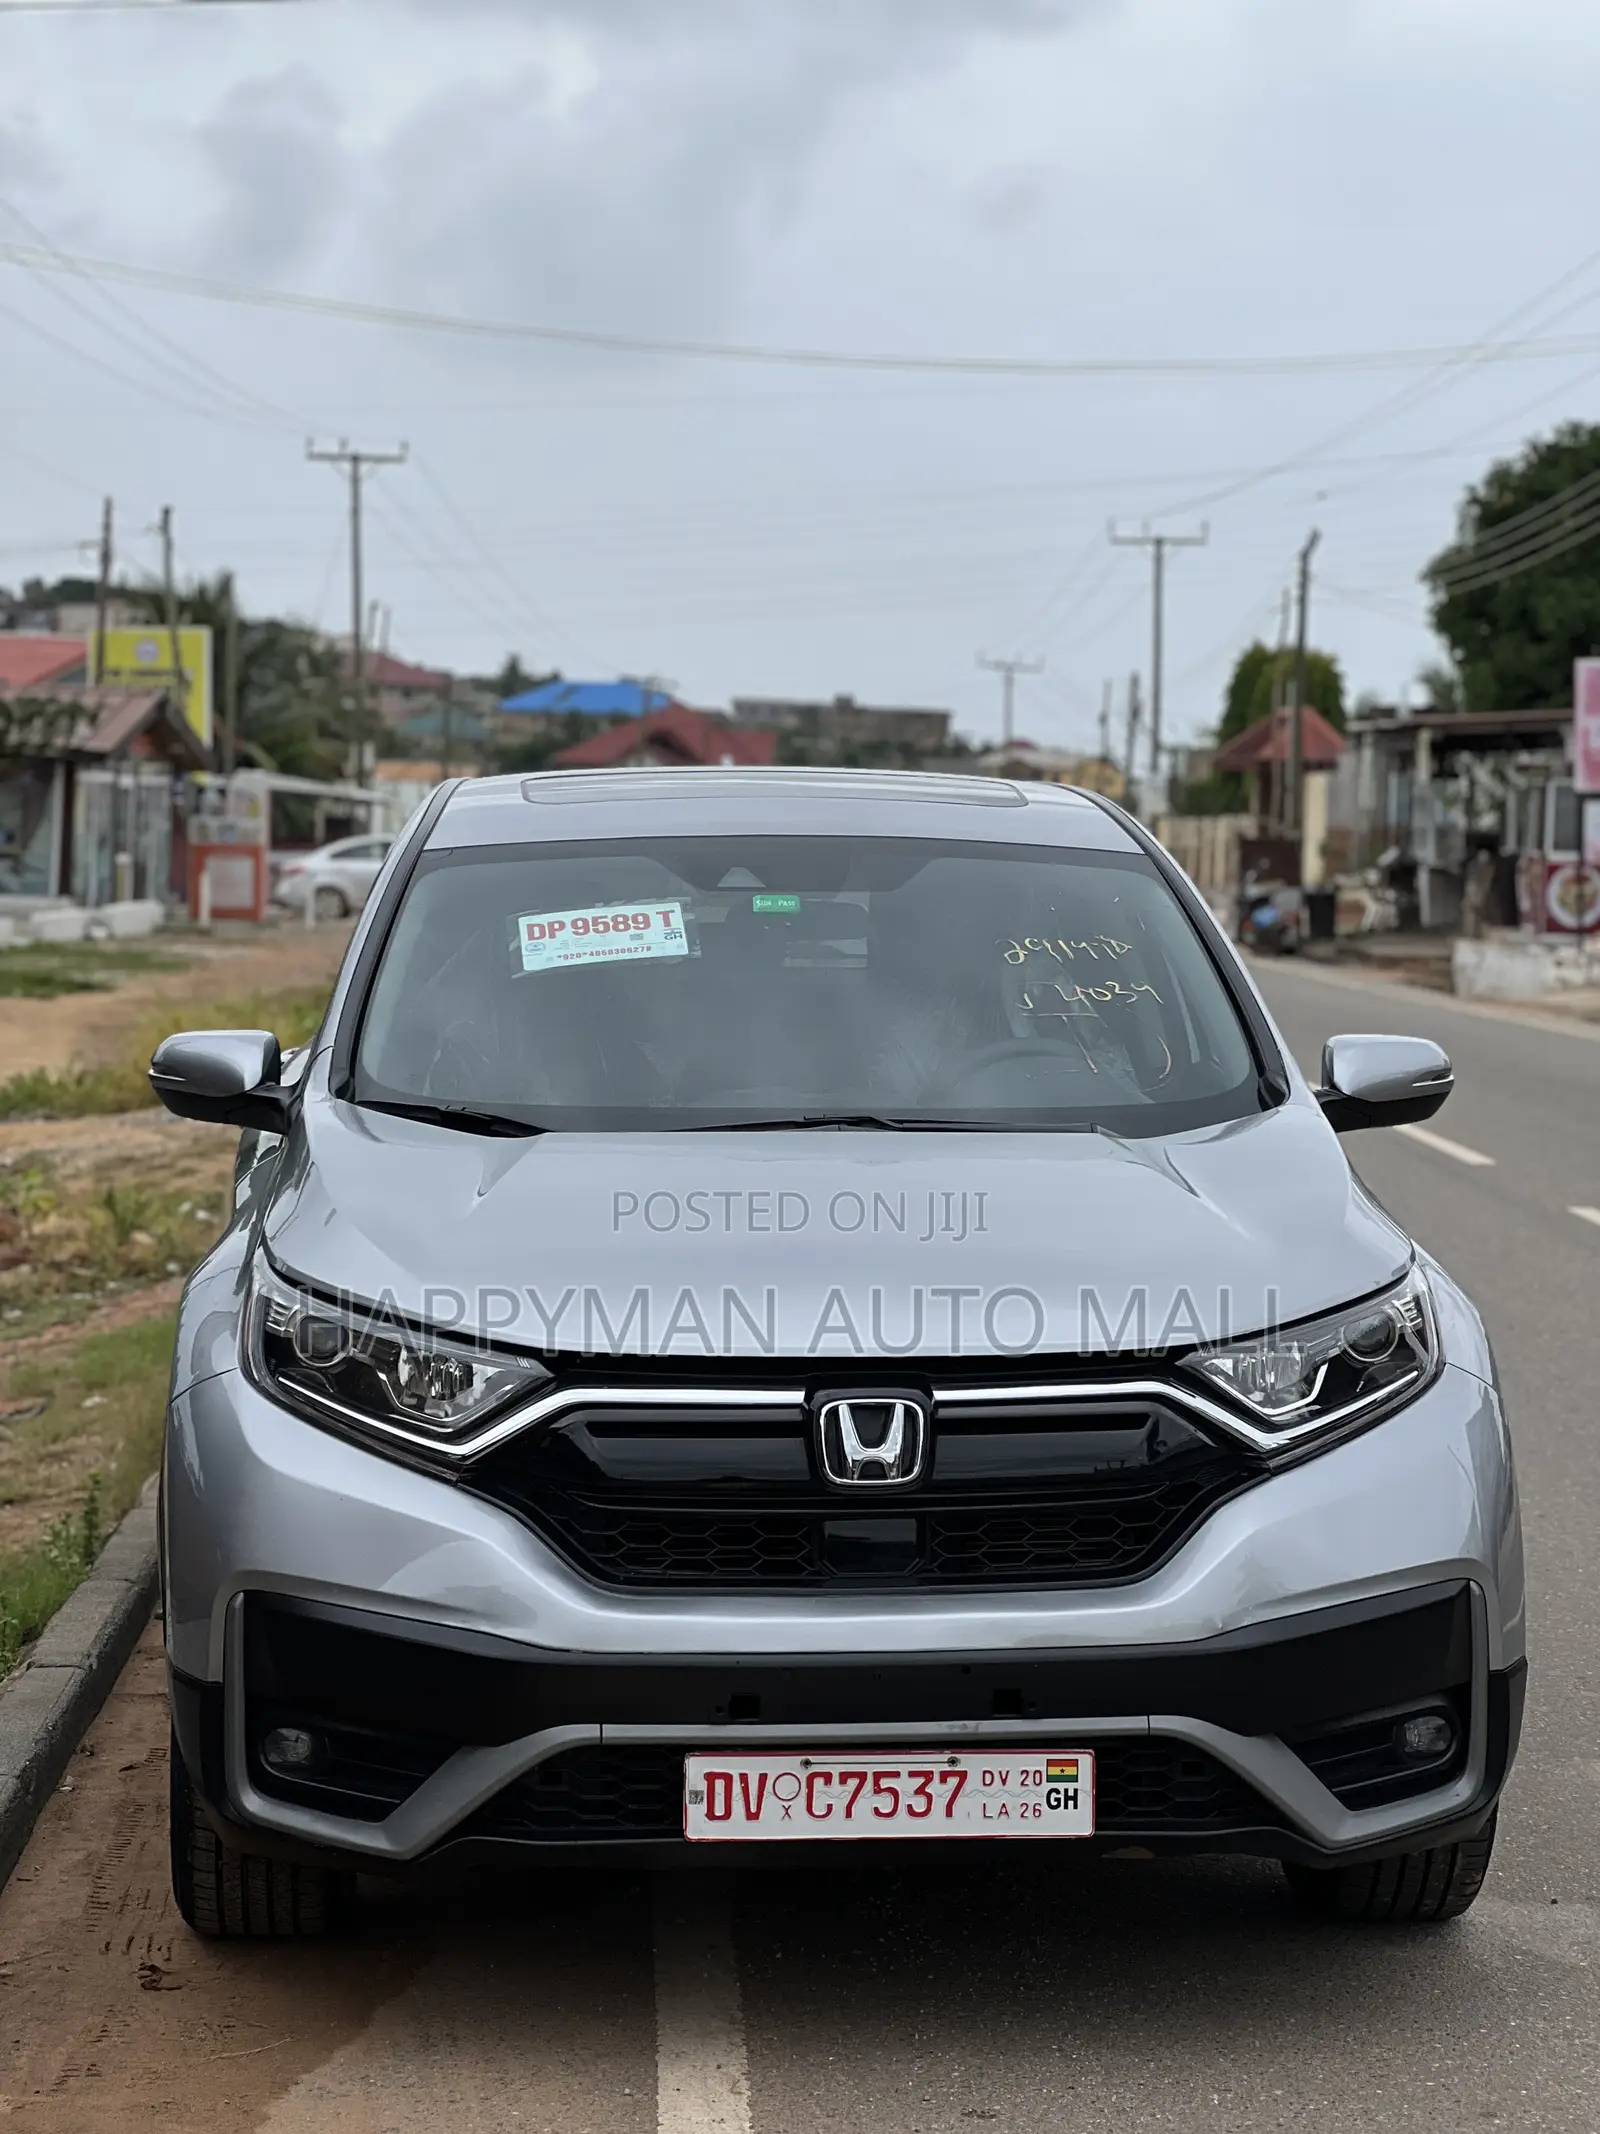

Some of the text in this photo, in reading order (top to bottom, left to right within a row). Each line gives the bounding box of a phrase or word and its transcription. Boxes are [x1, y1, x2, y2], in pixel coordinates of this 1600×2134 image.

[526, 909, 675, 941] DP 9589 T
[664, 933, 683, 941] GH
[982, 1770, 1043, 1787] DV 20
[703, 1770, 969, 1821] DV C7537
[1046, 1787, 1079, 1810] GH
[982, 1802, 1042, 1819] LA 26
